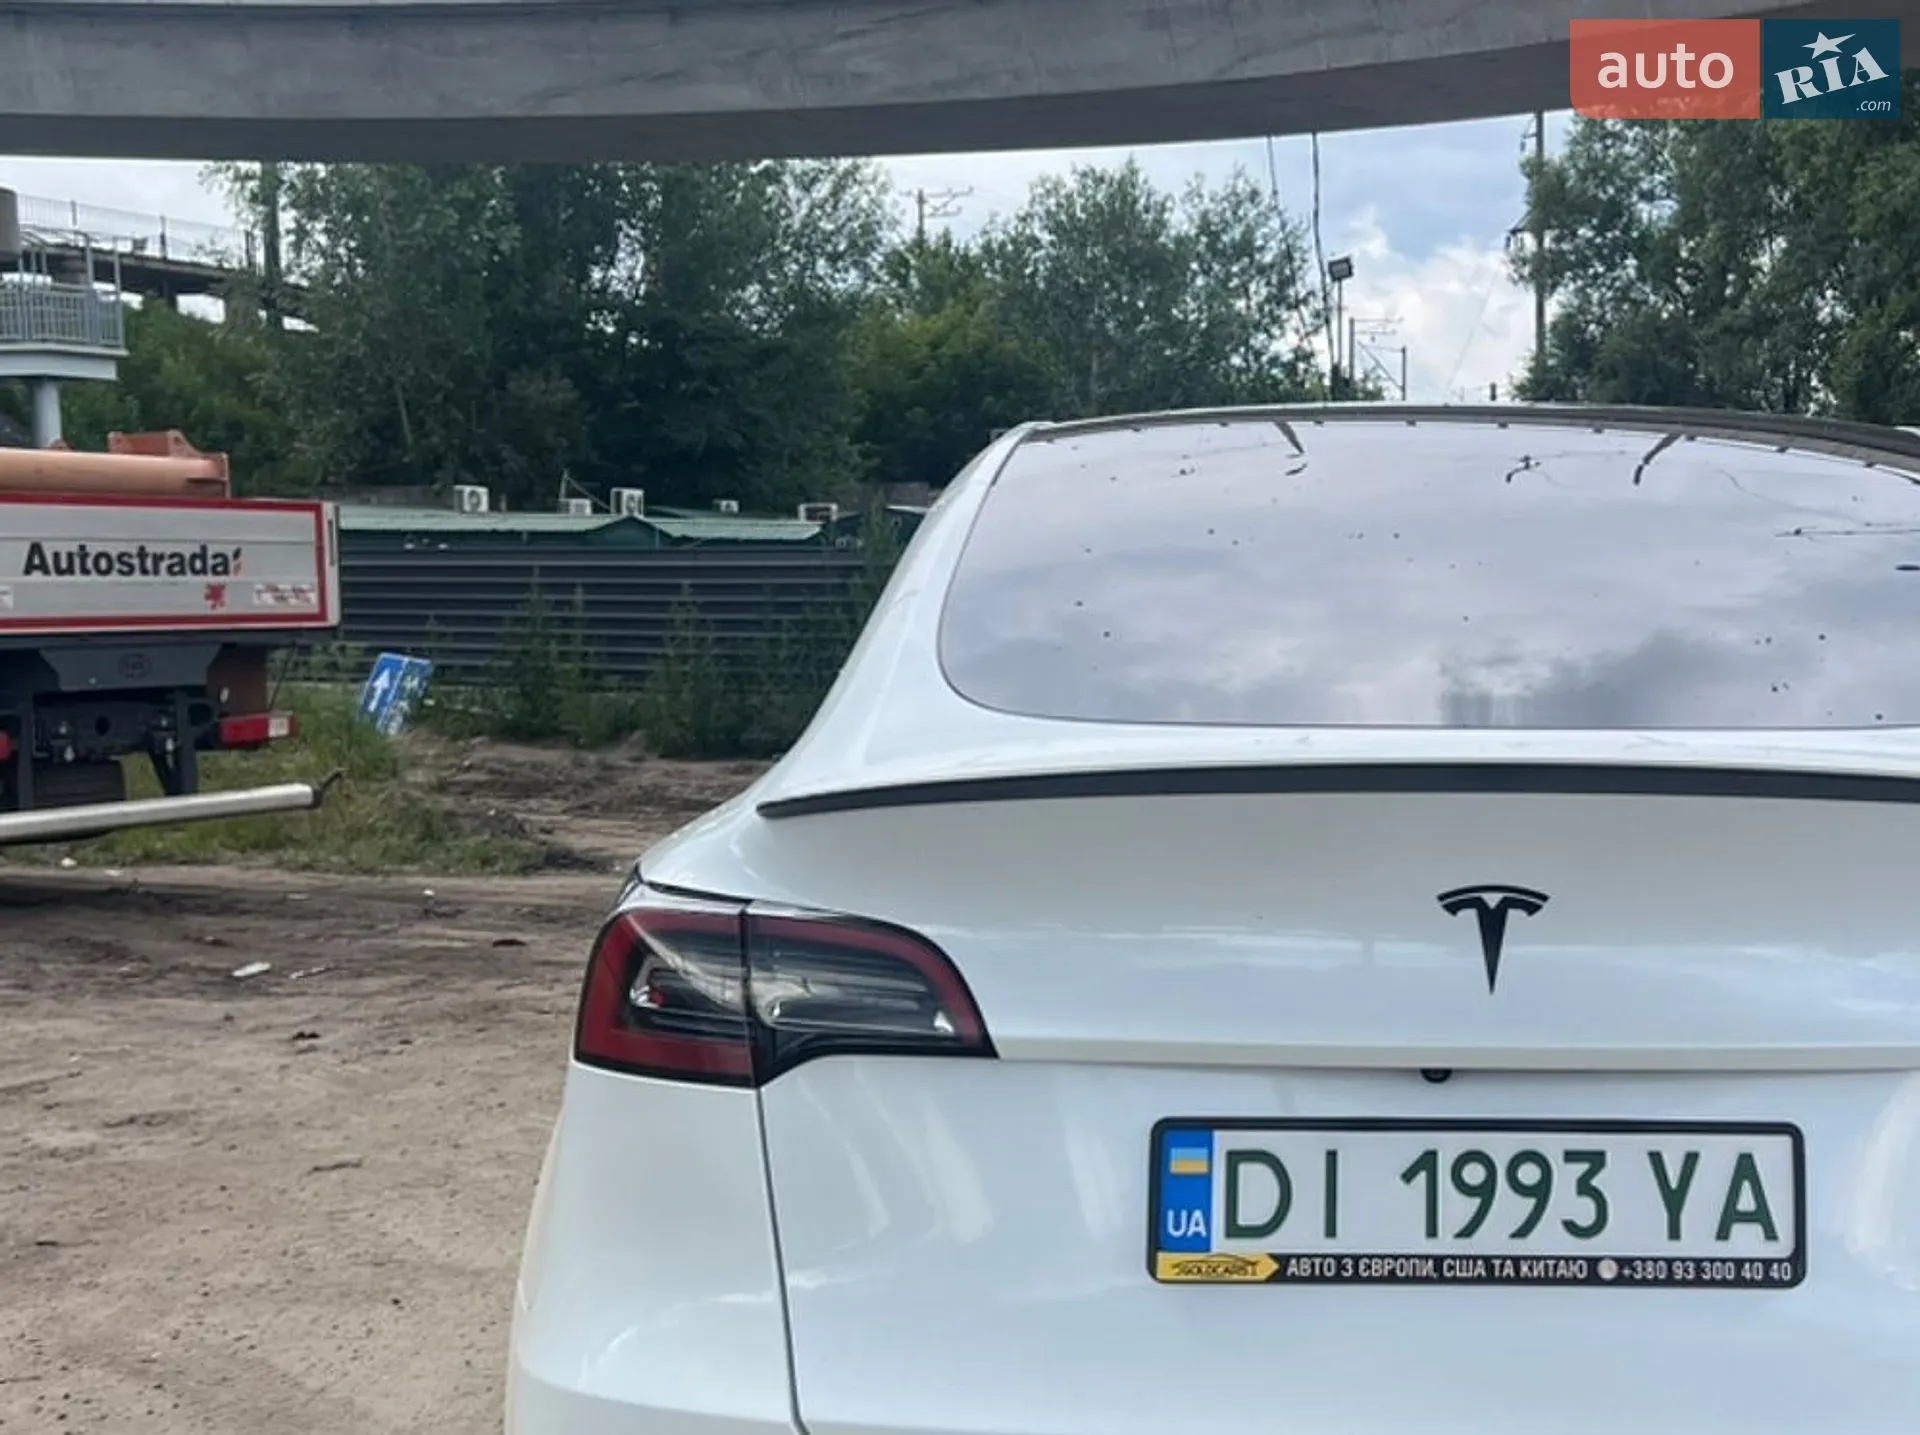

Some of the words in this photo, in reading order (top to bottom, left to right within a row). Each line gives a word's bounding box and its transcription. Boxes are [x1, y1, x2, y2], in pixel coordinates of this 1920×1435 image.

[23, 541, 231, 577] Autostrada
[1225, 1149, 1337, 1239] DI
[1400, 1149, 1609, 1240] 1993
[1647, 1150, 1779, 1242] YA
[1167, 1209, 1207, 1238] UA
[1286, 1257, 1335, 1277] АВТО
[1358, 1257, 1437, 1278] ЄВРОПИ,
[1443, 1259, 1486, 1277] США
[1492, 1259, 1515, 1277] ТА
[1519, 1259, 1588, 1279] КИТАЮ
[1621, 1260, 1667, 1279] +380
[1672, 1260, 1695, 1280] 93
[1701, 1261, 1735, 1280] 300
[1741, 1262, 1763, 1280] 40
[1769, 1262, 1791, 1280] 40
